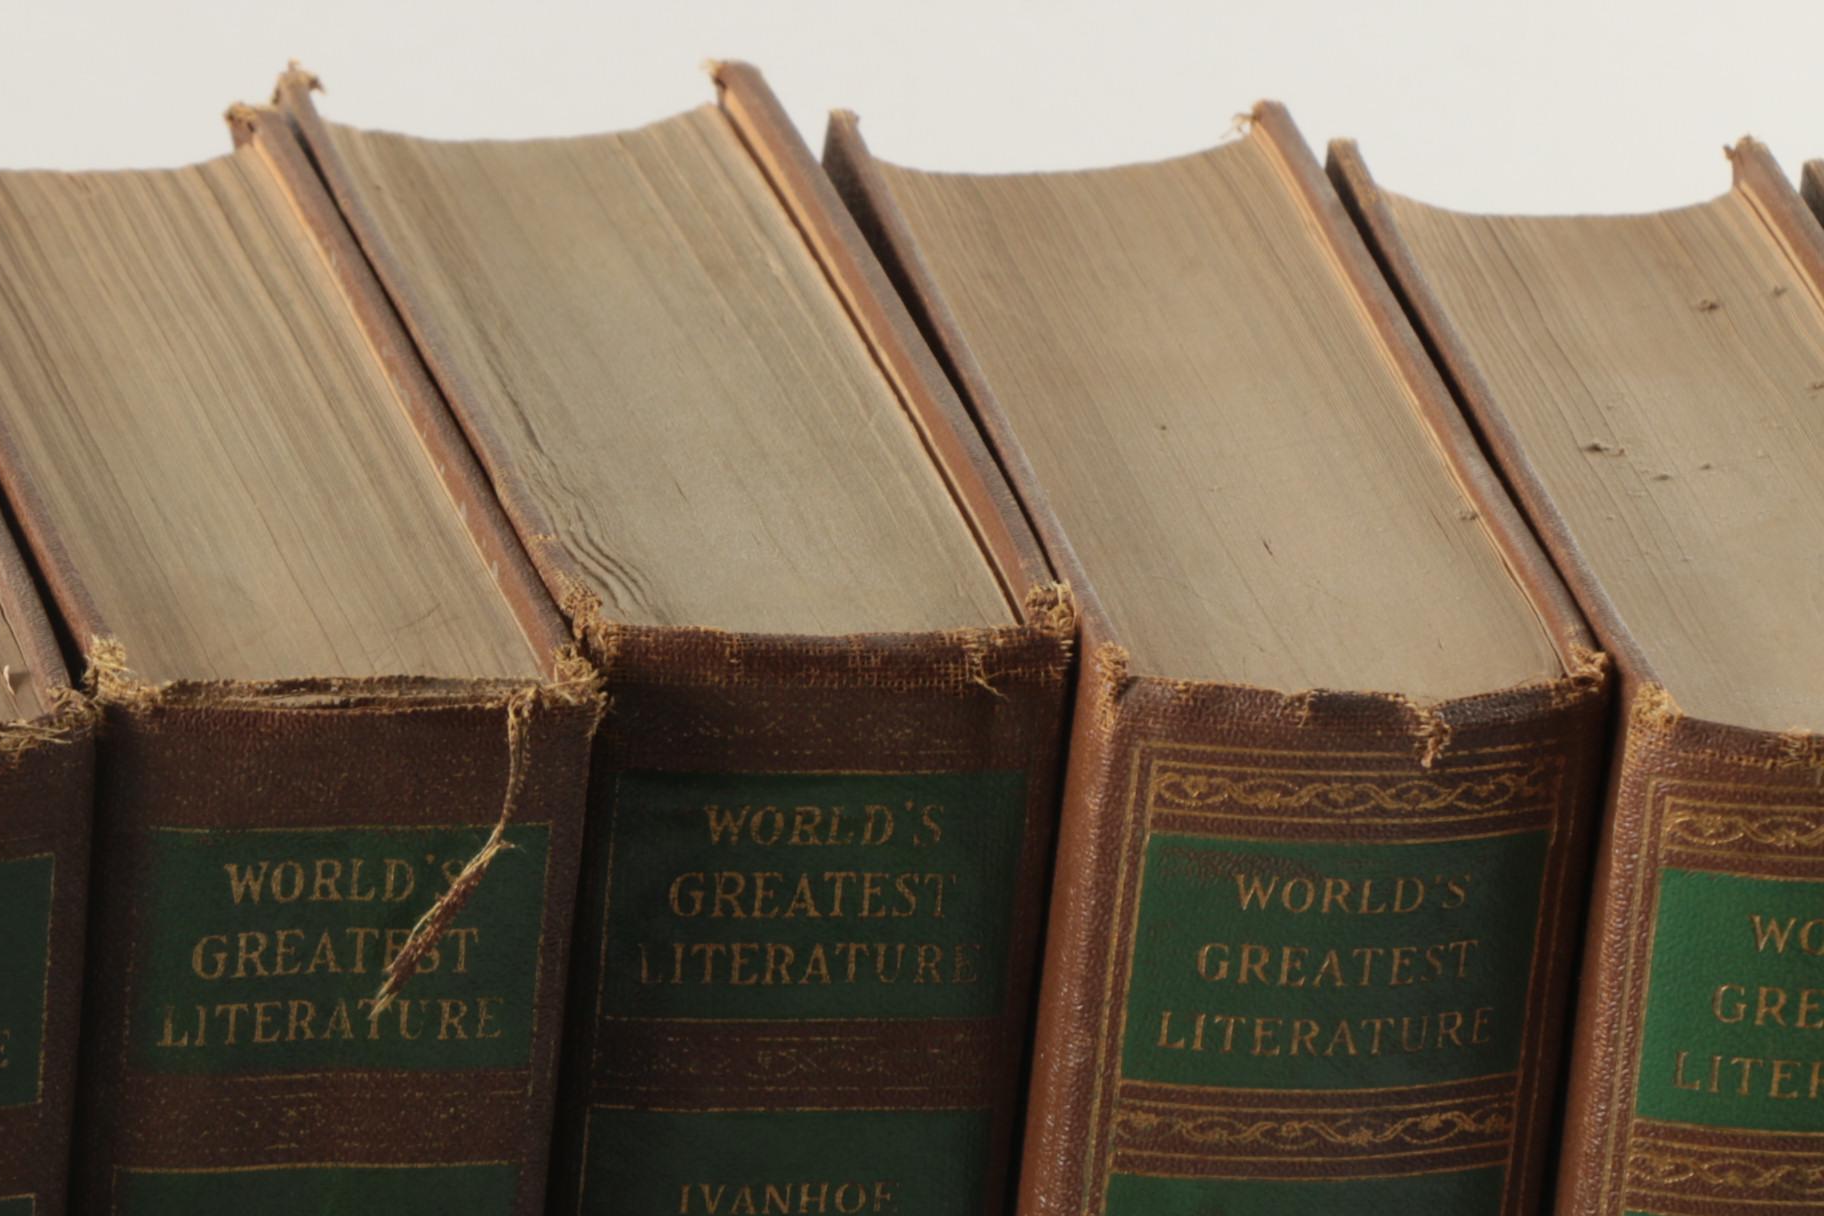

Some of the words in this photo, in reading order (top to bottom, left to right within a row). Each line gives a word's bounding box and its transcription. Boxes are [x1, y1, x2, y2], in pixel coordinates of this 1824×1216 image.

[704, 799, 946, 847] WORLD'S
[668, 871, 958, 919] GREATEST
[1234, 872, 1473, 914] WORLD'S
[191, 927, 480, 981] GREATEST
[637, 942, 980, 985] LITERATURE
[1196, 939, 1480, 988] GREATEST
[157, 996, 504, 1048] LITERATURE
[1157, 1006, 1494, 1056] LITERATURE
[678, 1181, 902, 1216] IVANHOE
